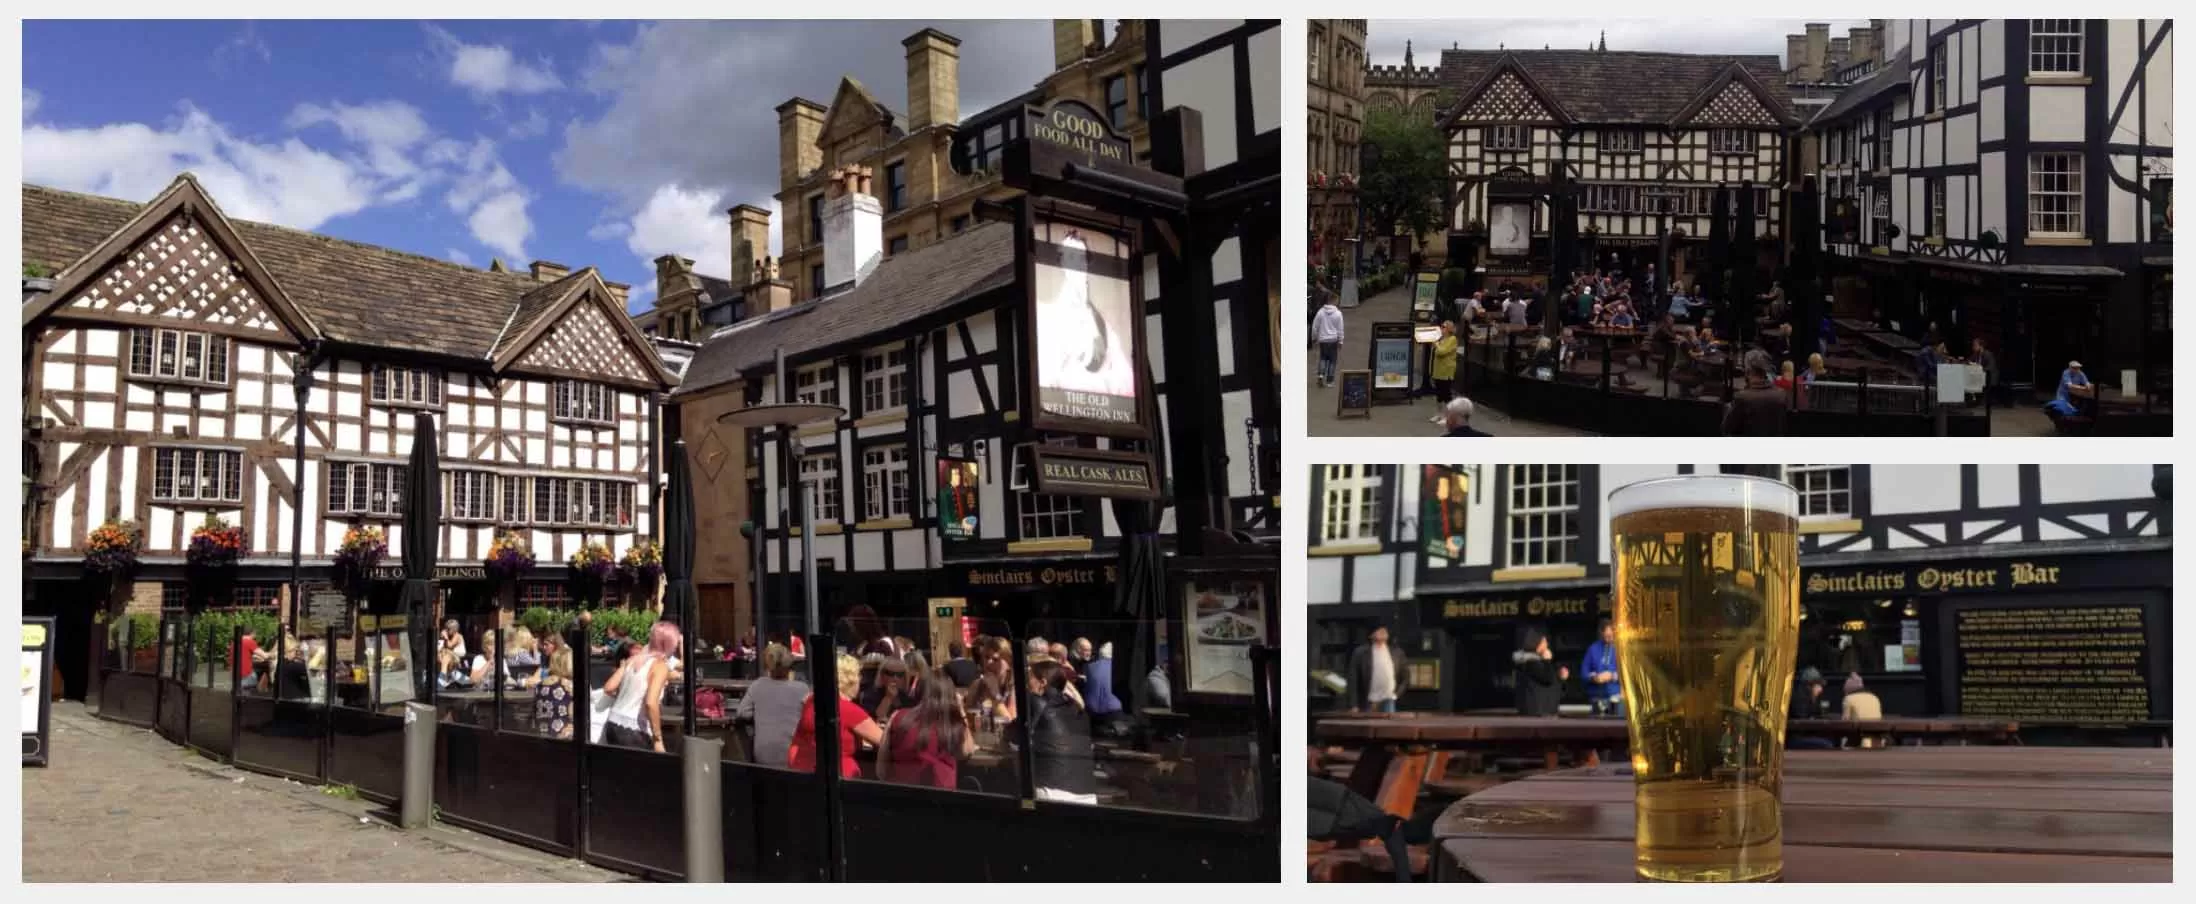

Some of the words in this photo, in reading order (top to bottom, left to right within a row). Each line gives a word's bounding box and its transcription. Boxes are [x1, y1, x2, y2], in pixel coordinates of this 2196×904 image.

[1053, 110, 1103, 139] GOOD
[1034, 123, 1069, 145] FOOD
[1072, 136, 1095, 153] ALL
[1100, 142, 1122, 160] DAY
[1065, 391, 1086, 405] THE
[1087, 393, 1109, 407] OLD
[1043, 402, 1111, 421] WELLINGTON
[1112, 409, 1131, 423] INN
[1044, 463, 1079, 478] REAL
[1080, 466, 1112, 481] CASK
[1114, 468, 1144, 482] ALES
[968, 568, 1033, 585] Sinclairs
[1040, 567, 1094, 587] Oyster
[1807, 570, 1905, 593] Sinclairs
[1917, 567, 1998, 592] Oyster
[2011, 562, 2059, 588] Bar
